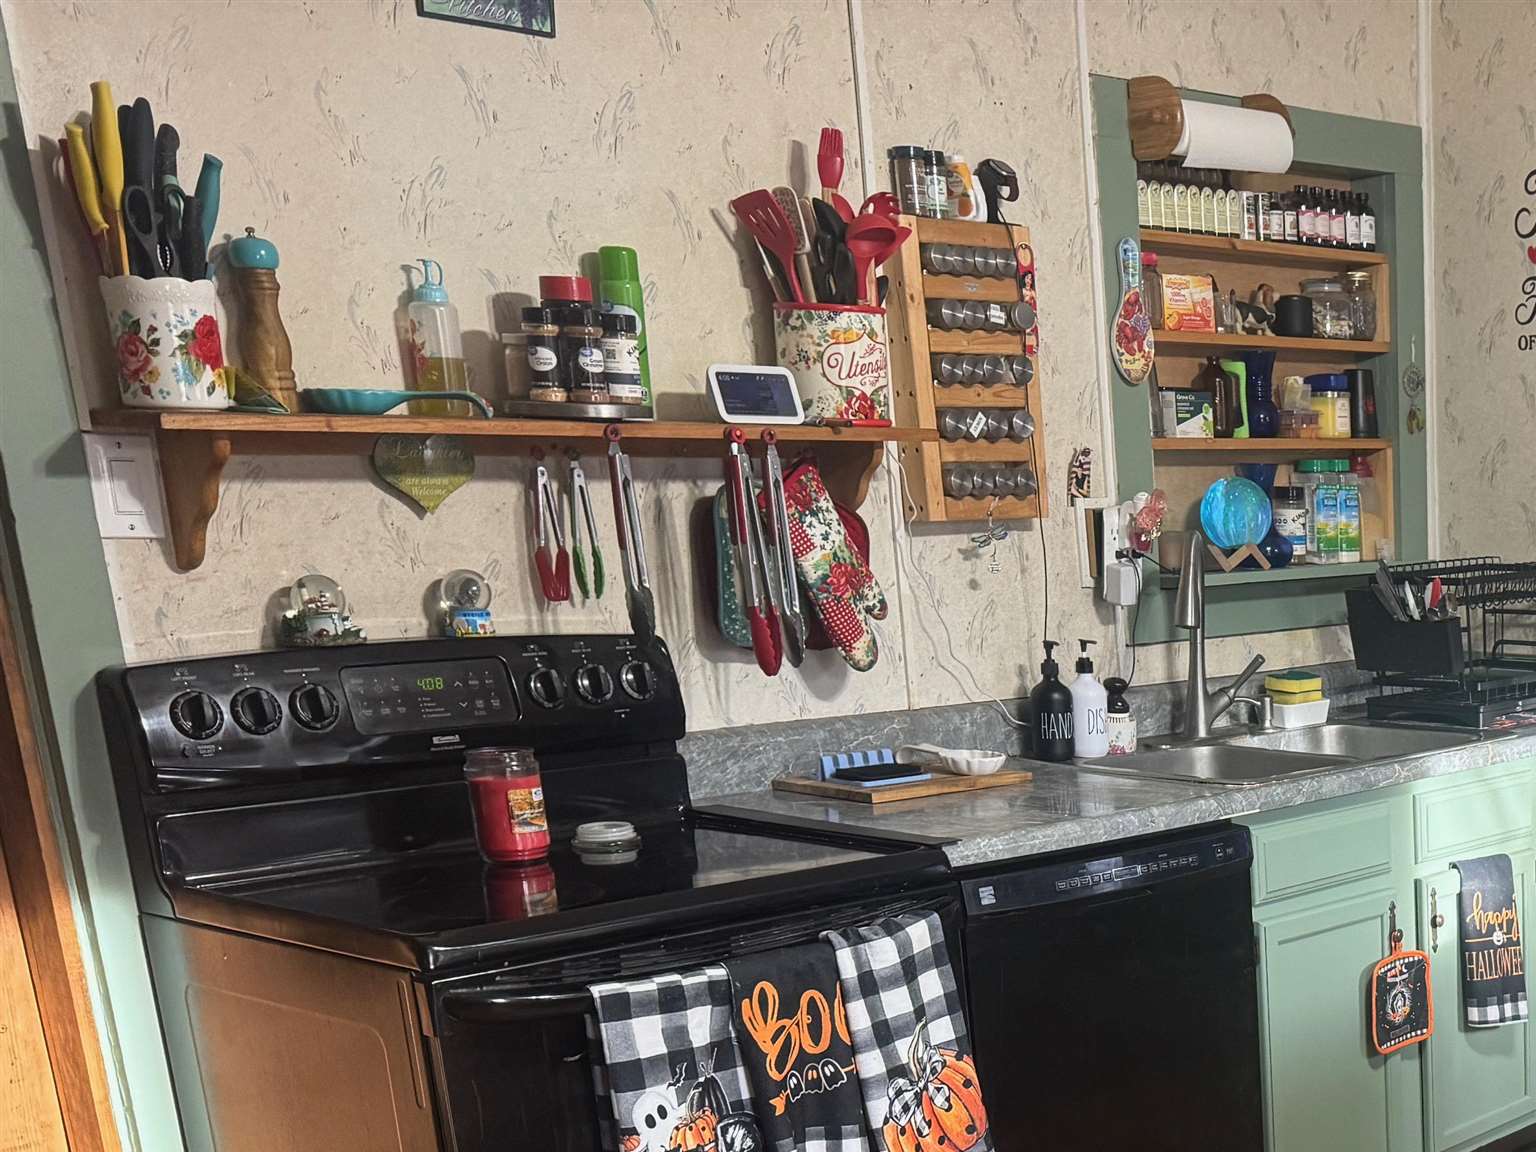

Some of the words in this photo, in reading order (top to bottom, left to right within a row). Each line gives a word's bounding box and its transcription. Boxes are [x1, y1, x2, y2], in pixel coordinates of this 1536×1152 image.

[1041, 711, 1073, 740] HAND
[1087, 708, 1106, 735] DIS
[1466, 891, 1520, 942] happy
[1465, 946, 1524, 981] HALLOWEE
